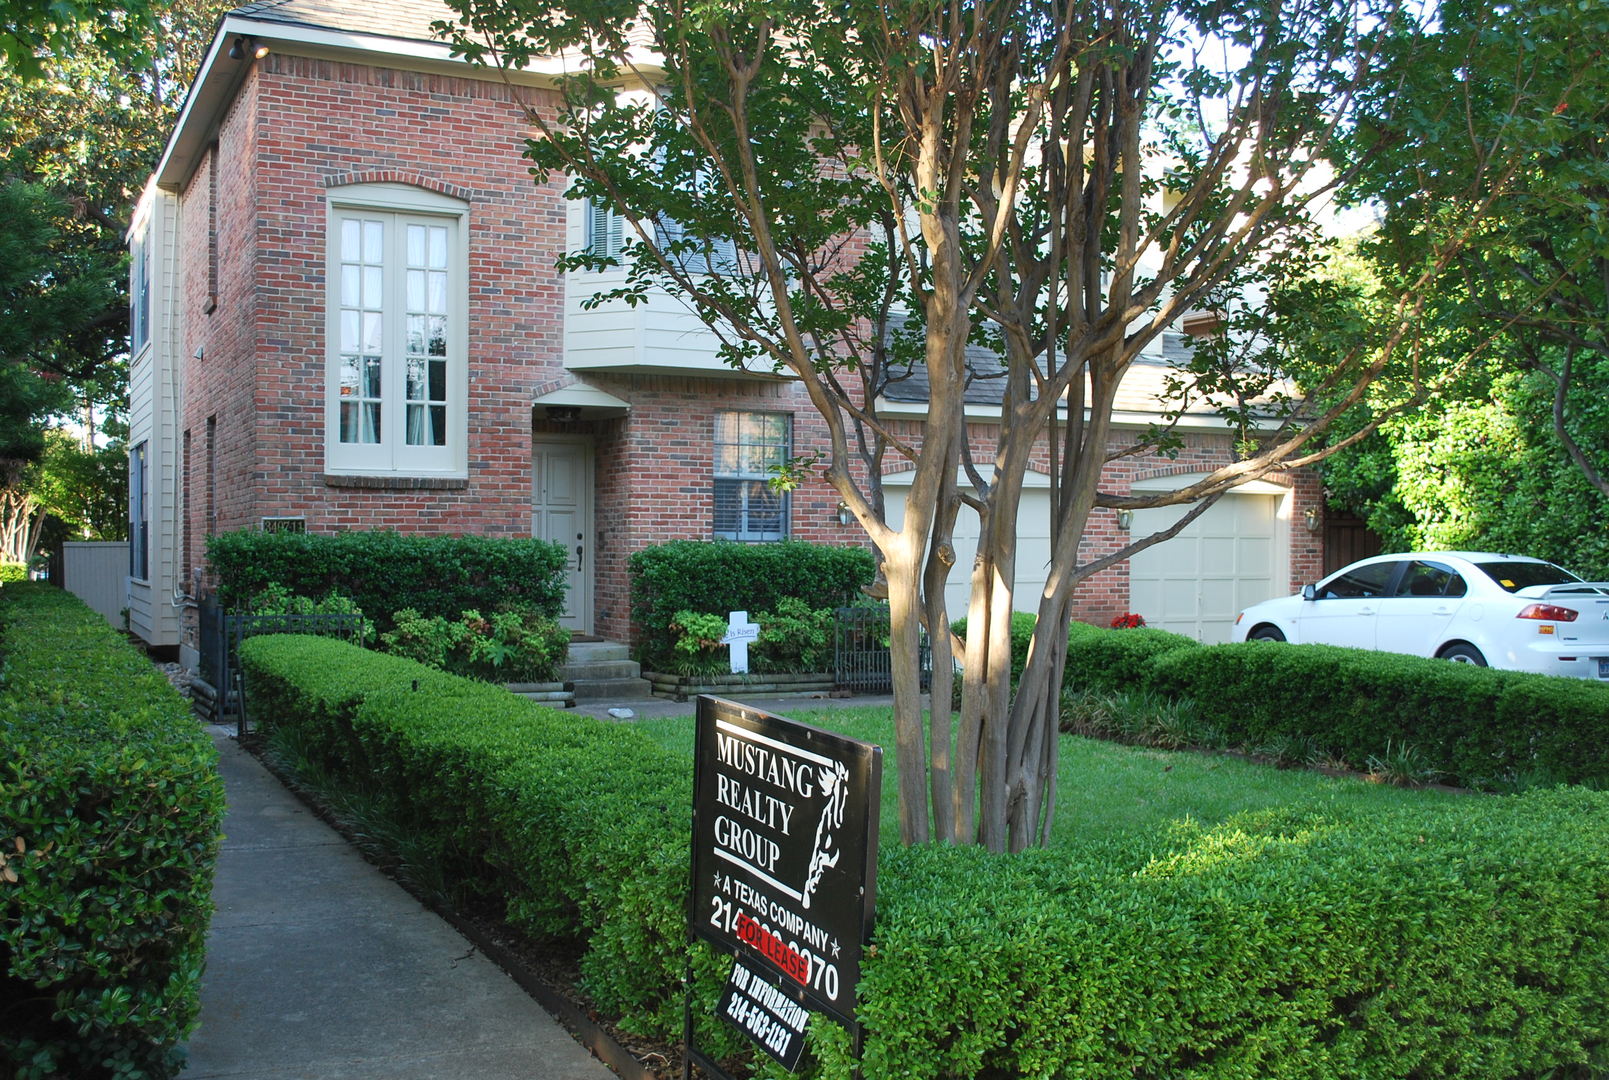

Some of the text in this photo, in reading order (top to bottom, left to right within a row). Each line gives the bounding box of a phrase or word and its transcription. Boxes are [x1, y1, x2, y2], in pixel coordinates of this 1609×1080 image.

[716, 732, 813, 798] MUSTANG
[716, 772, 794, 836] REALTY
[714, 815, 780, 874] GROUP
[722, 875, 829, 953] A TEXAS COMPANY
[738, 916, 806, 982] FOR LEASE
[727, 992, 792, 1058] 214-563-1131
[731, 963, 811, 1034] FOR INFORMATION
